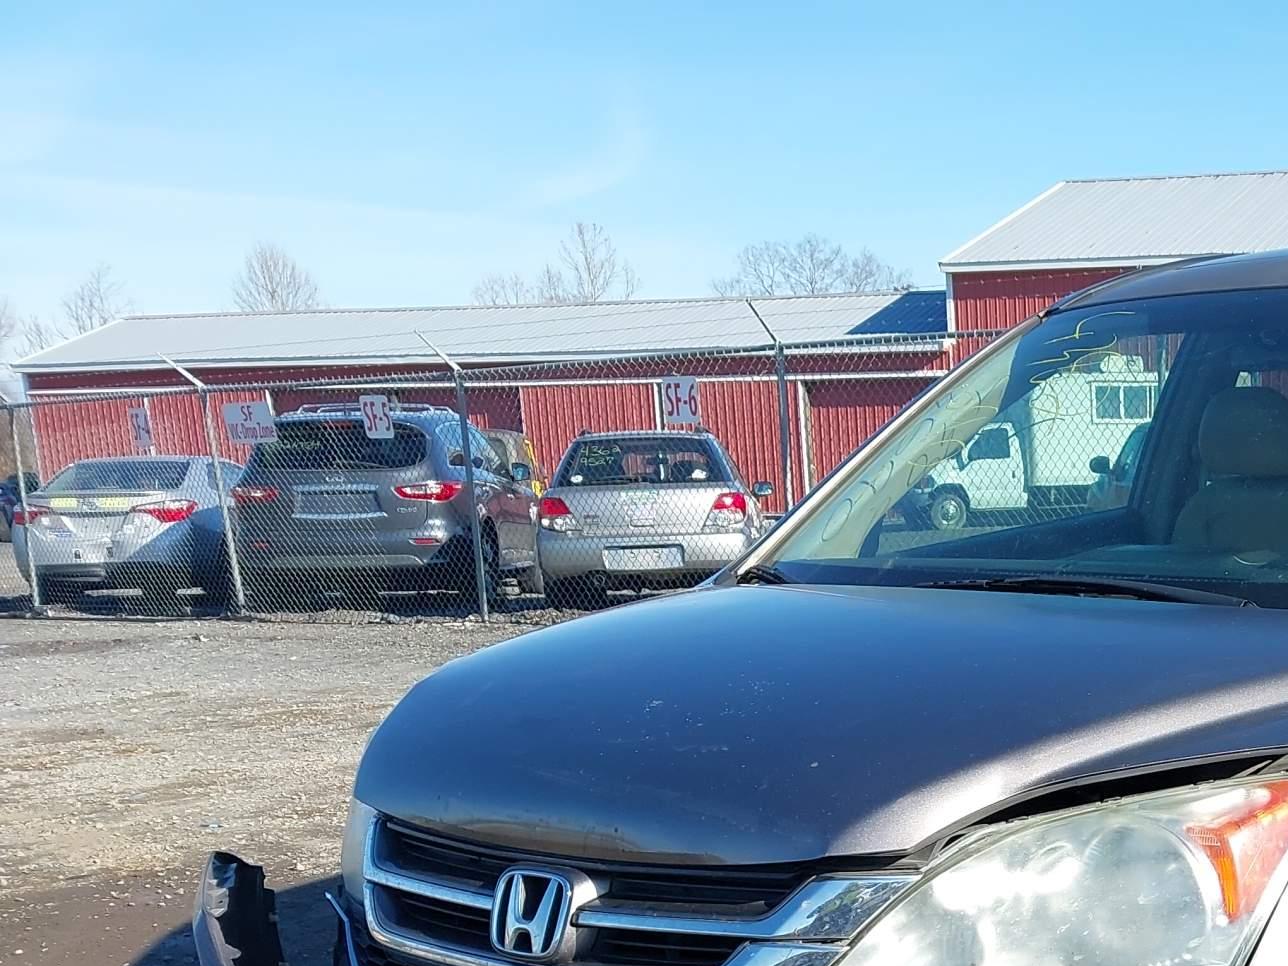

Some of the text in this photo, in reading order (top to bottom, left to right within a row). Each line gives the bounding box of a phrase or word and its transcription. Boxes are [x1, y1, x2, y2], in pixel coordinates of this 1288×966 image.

[240, 405, 253, 422] SF
[665, 382, 698, 417] SF-6
[131, 413, 152, 441] SF-4
[362, 401, 391, 432] SF-5
